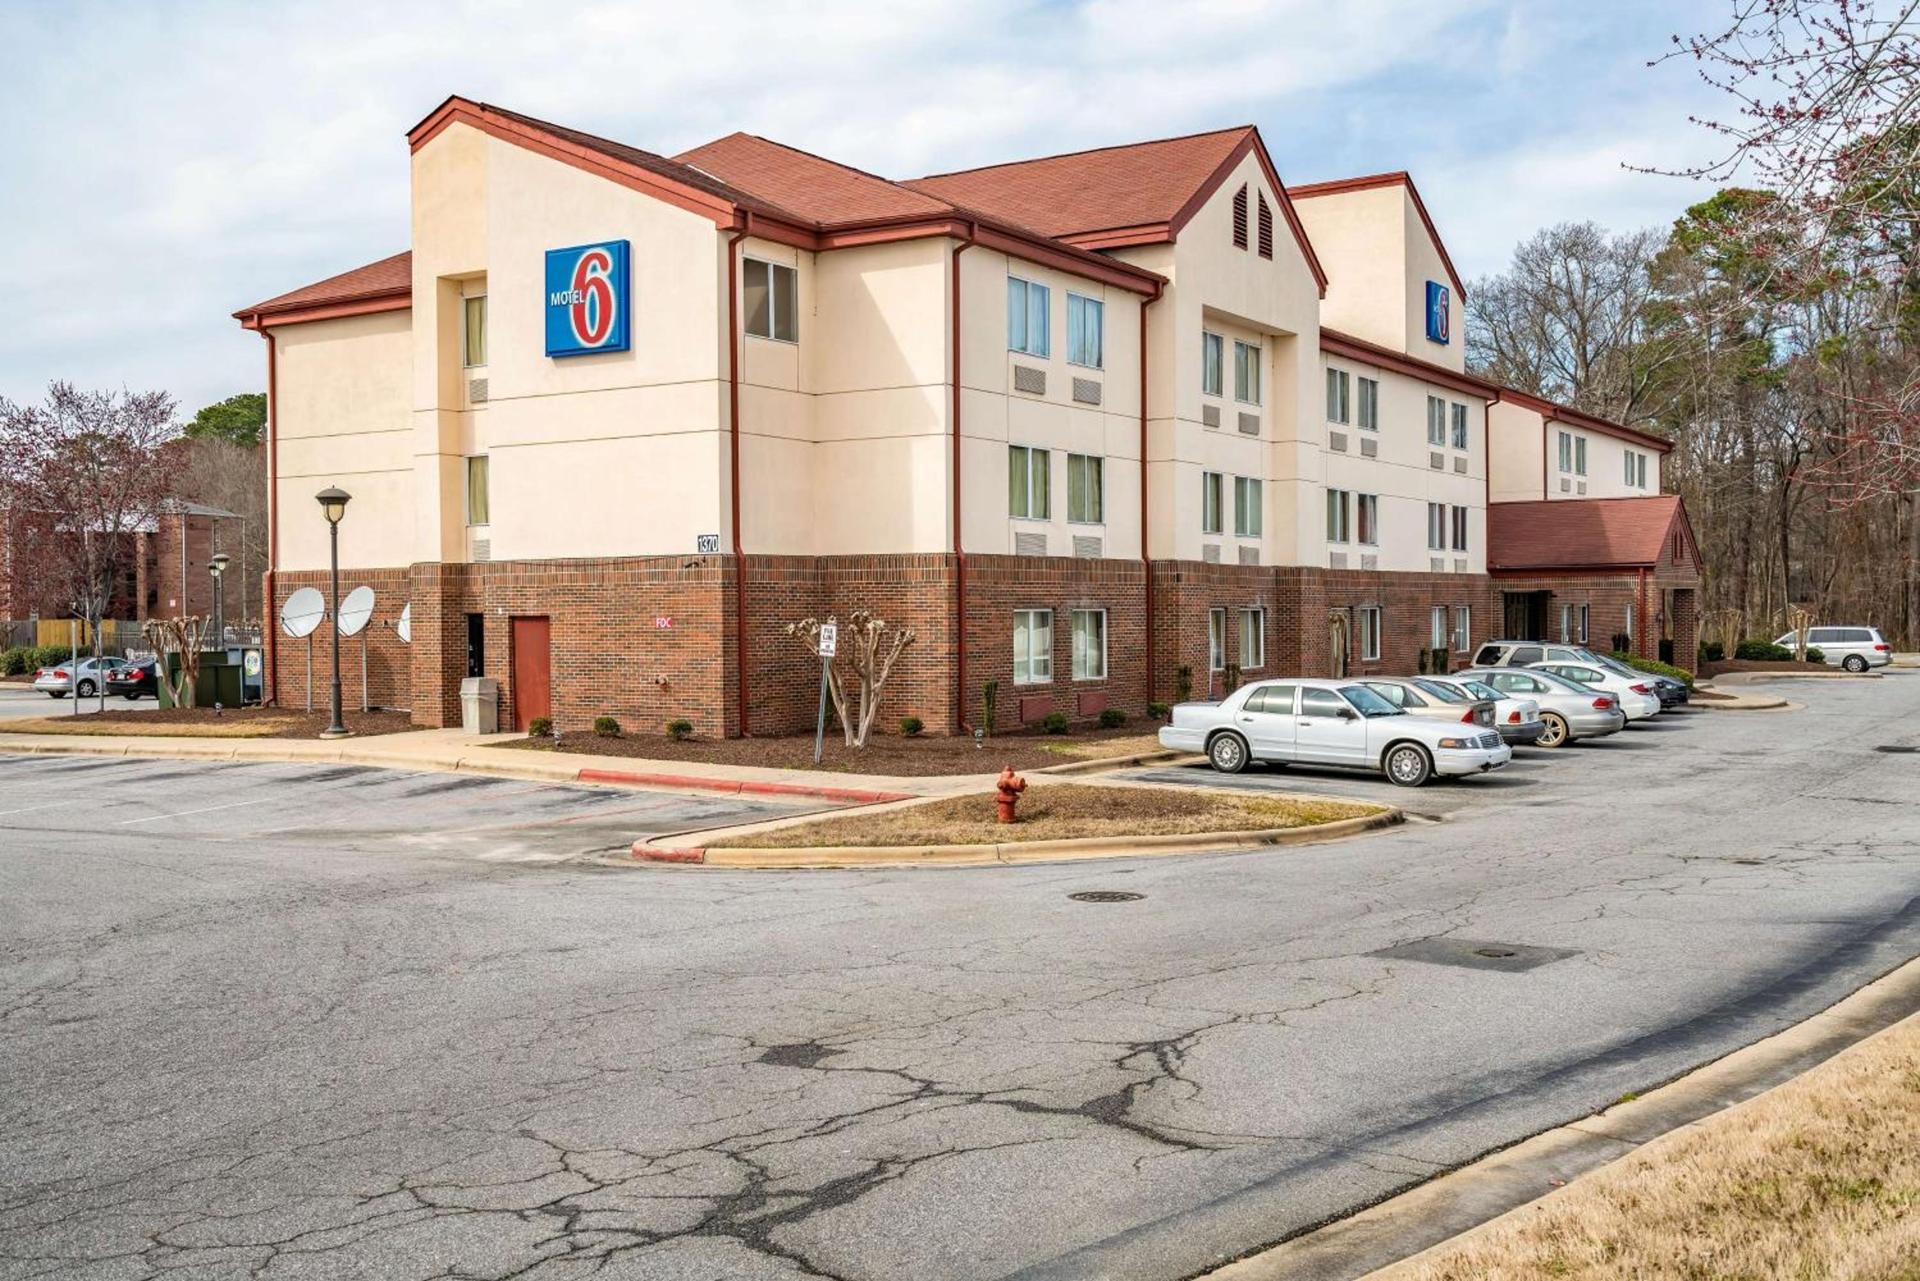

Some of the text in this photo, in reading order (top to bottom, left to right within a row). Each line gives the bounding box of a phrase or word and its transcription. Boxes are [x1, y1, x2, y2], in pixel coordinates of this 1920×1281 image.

[551, 248, 616, 348] MOTEL 6
[1437, 288, 1449, 341] 6
[698, 536, 718, 552] 1370
